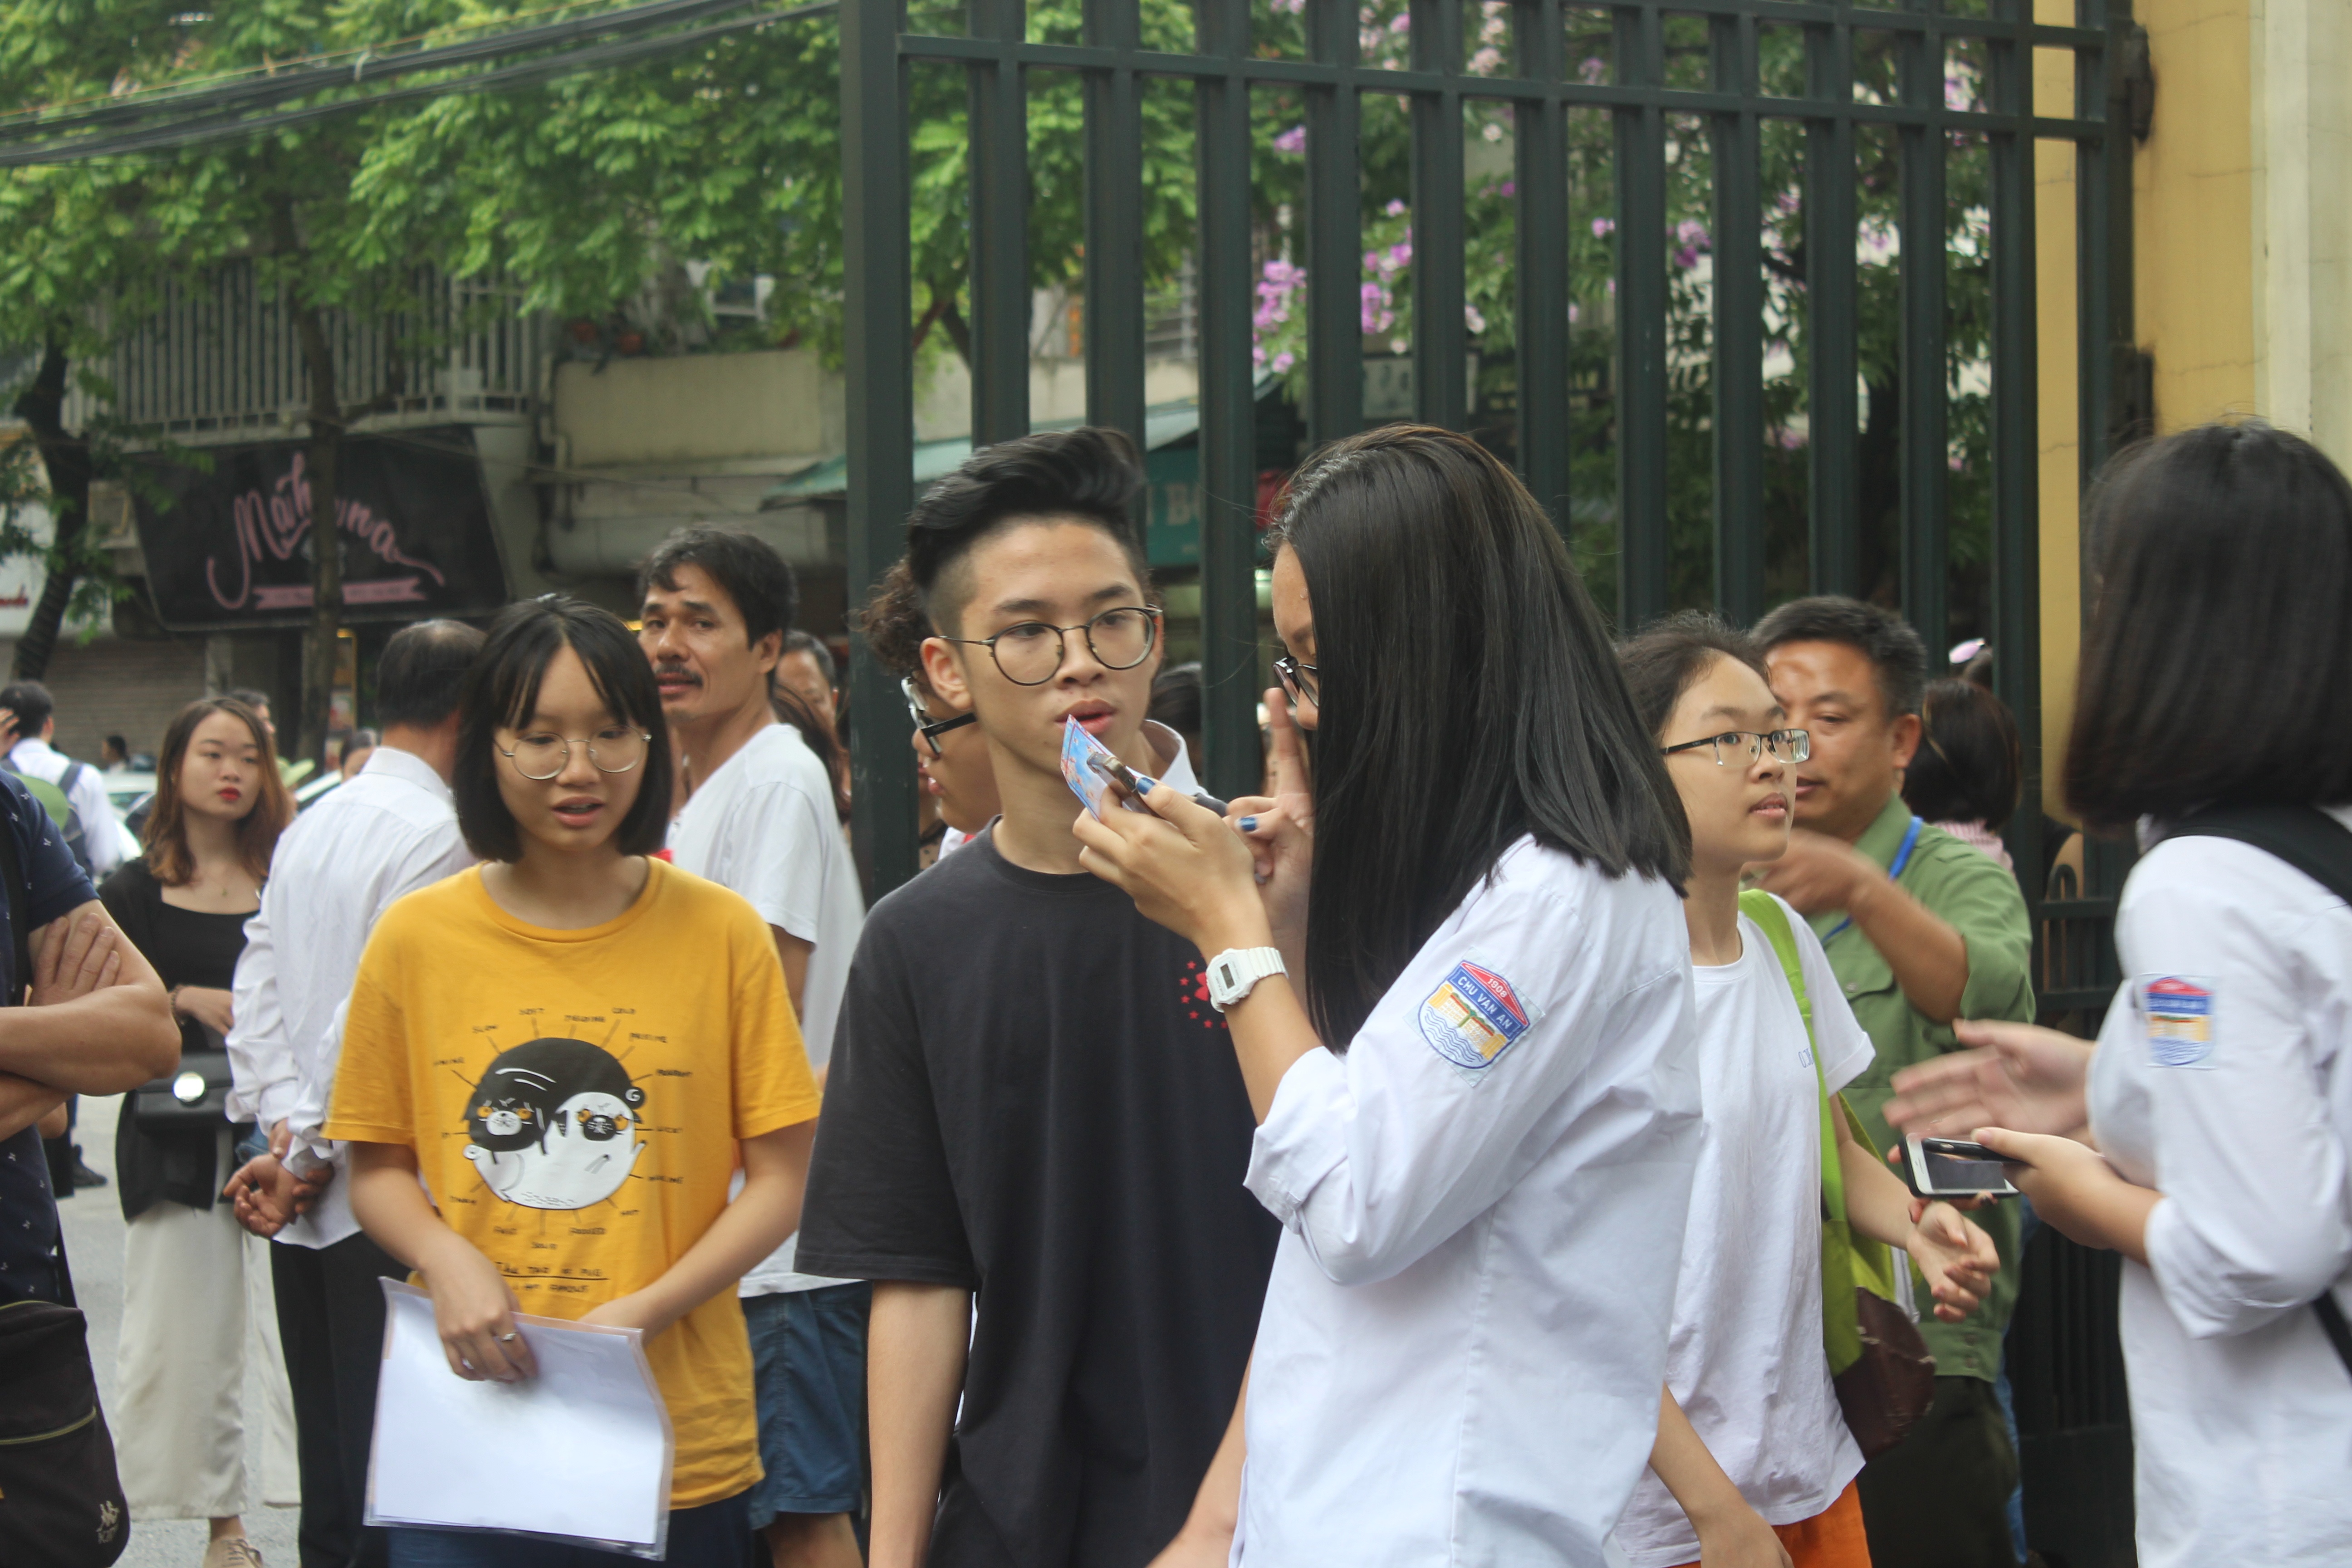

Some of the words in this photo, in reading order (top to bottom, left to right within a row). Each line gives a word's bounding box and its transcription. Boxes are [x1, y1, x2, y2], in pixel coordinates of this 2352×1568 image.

[1457, 976, 1478, 995] CHU
[1477, 993, 1498, 1014] VAN
[1496, 1014, 1512, 1029] AN
[1487, 978, 1508, 998] 1908
